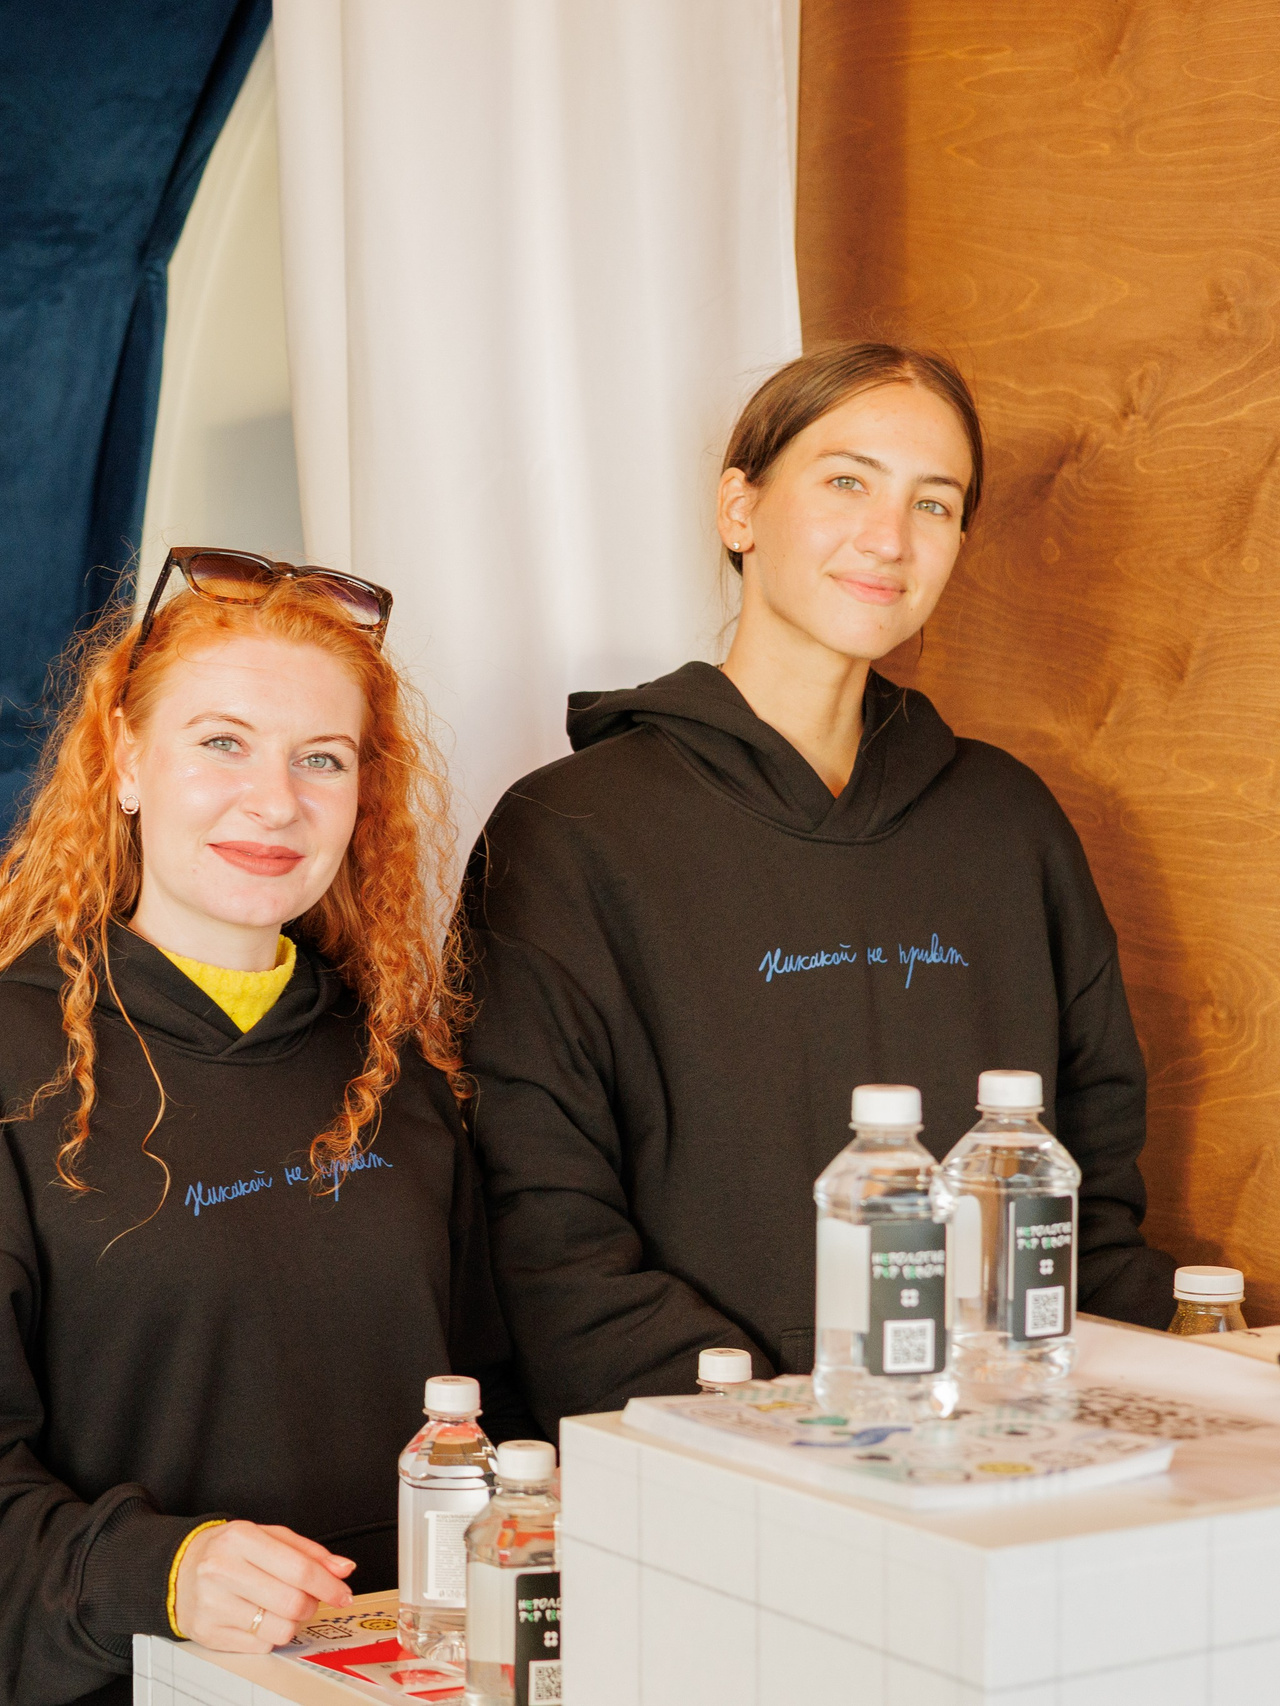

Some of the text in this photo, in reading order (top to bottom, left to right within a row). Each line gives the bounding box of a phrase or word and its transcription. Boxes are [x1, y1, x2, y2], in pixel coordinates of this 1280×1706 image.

[758, 943, 857, 983] Никакой
[867, 946, 887, 965] не
[184, 1169, 273, 1217] Никакой
[284, 1165, 309, 1186] не
